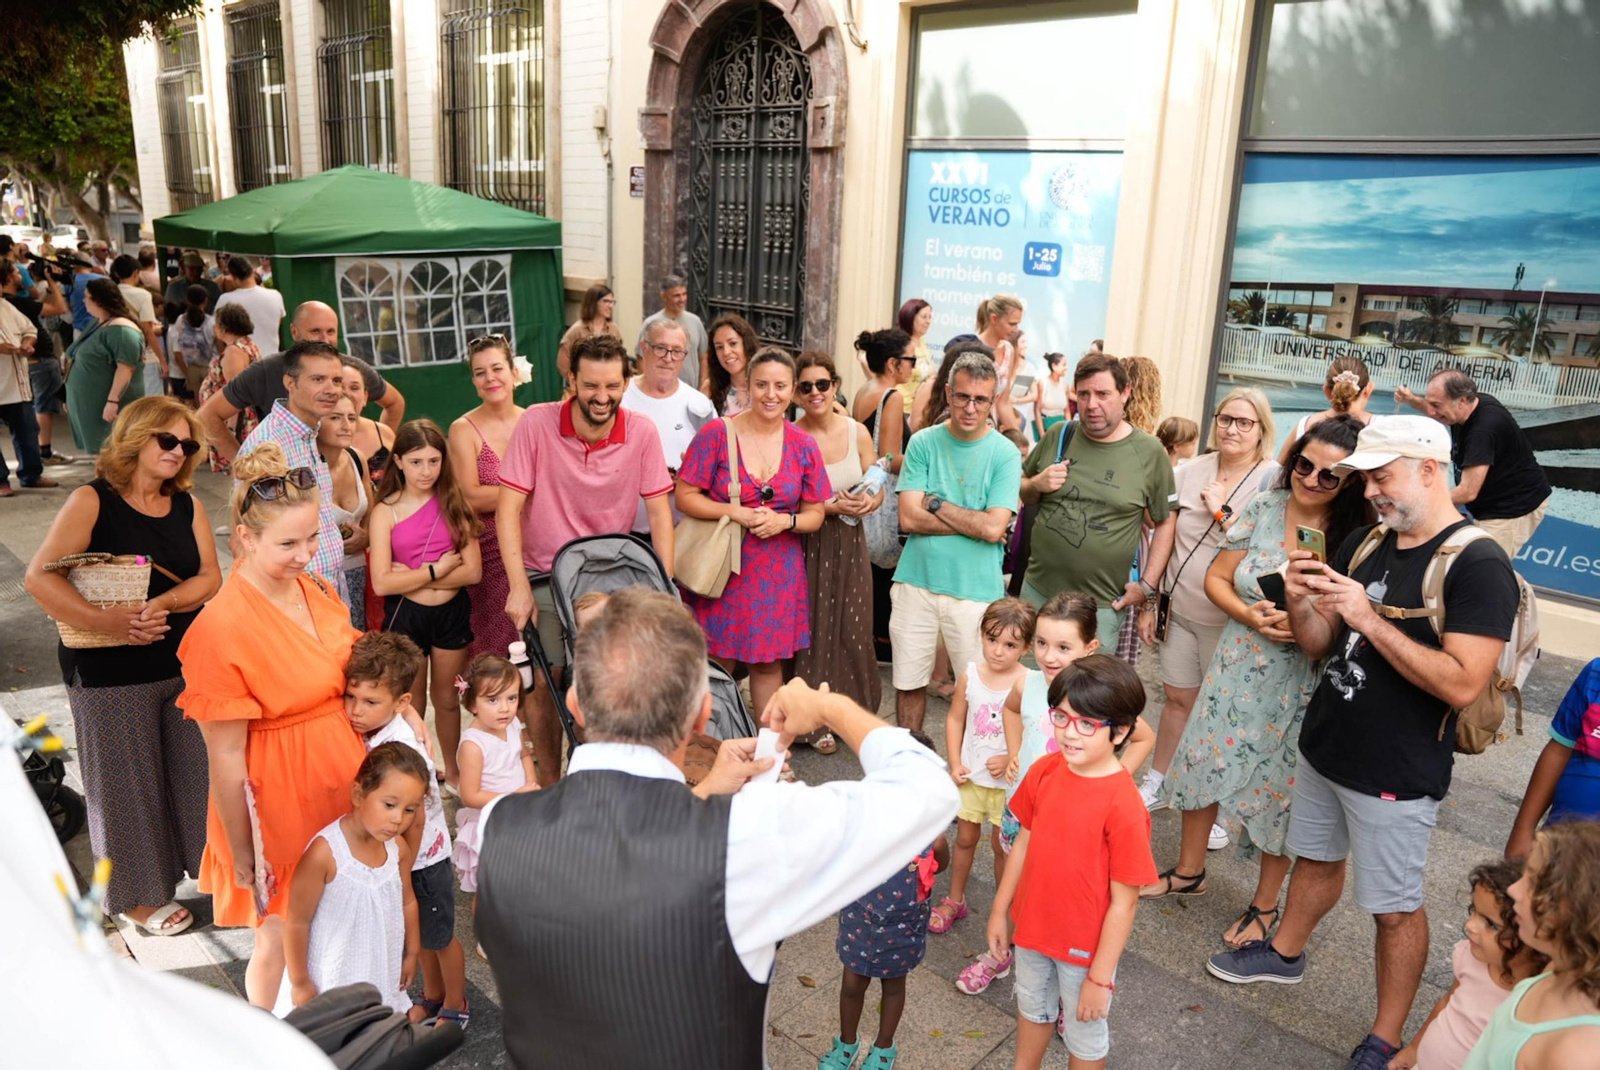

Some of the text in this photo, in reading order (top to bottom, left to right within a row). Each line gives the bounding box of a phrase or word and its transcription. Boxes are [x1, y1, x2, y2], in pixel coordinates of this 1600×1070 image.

[929, 161, 989, 185] XXVI
[929, 187, 1012, 204] CURSOS de
[928, 205, 1010, 227] VERANO
[925, 238, 1004, 260] El verano
[1028, 247, 1058, 262] 1-25
[924, 263, 1017, 286] también es
[1032, 261, 1052, 271] Julio
[1399, 355, 1424, 371] DE
[1513, 545, 1600, 577] ual.es
